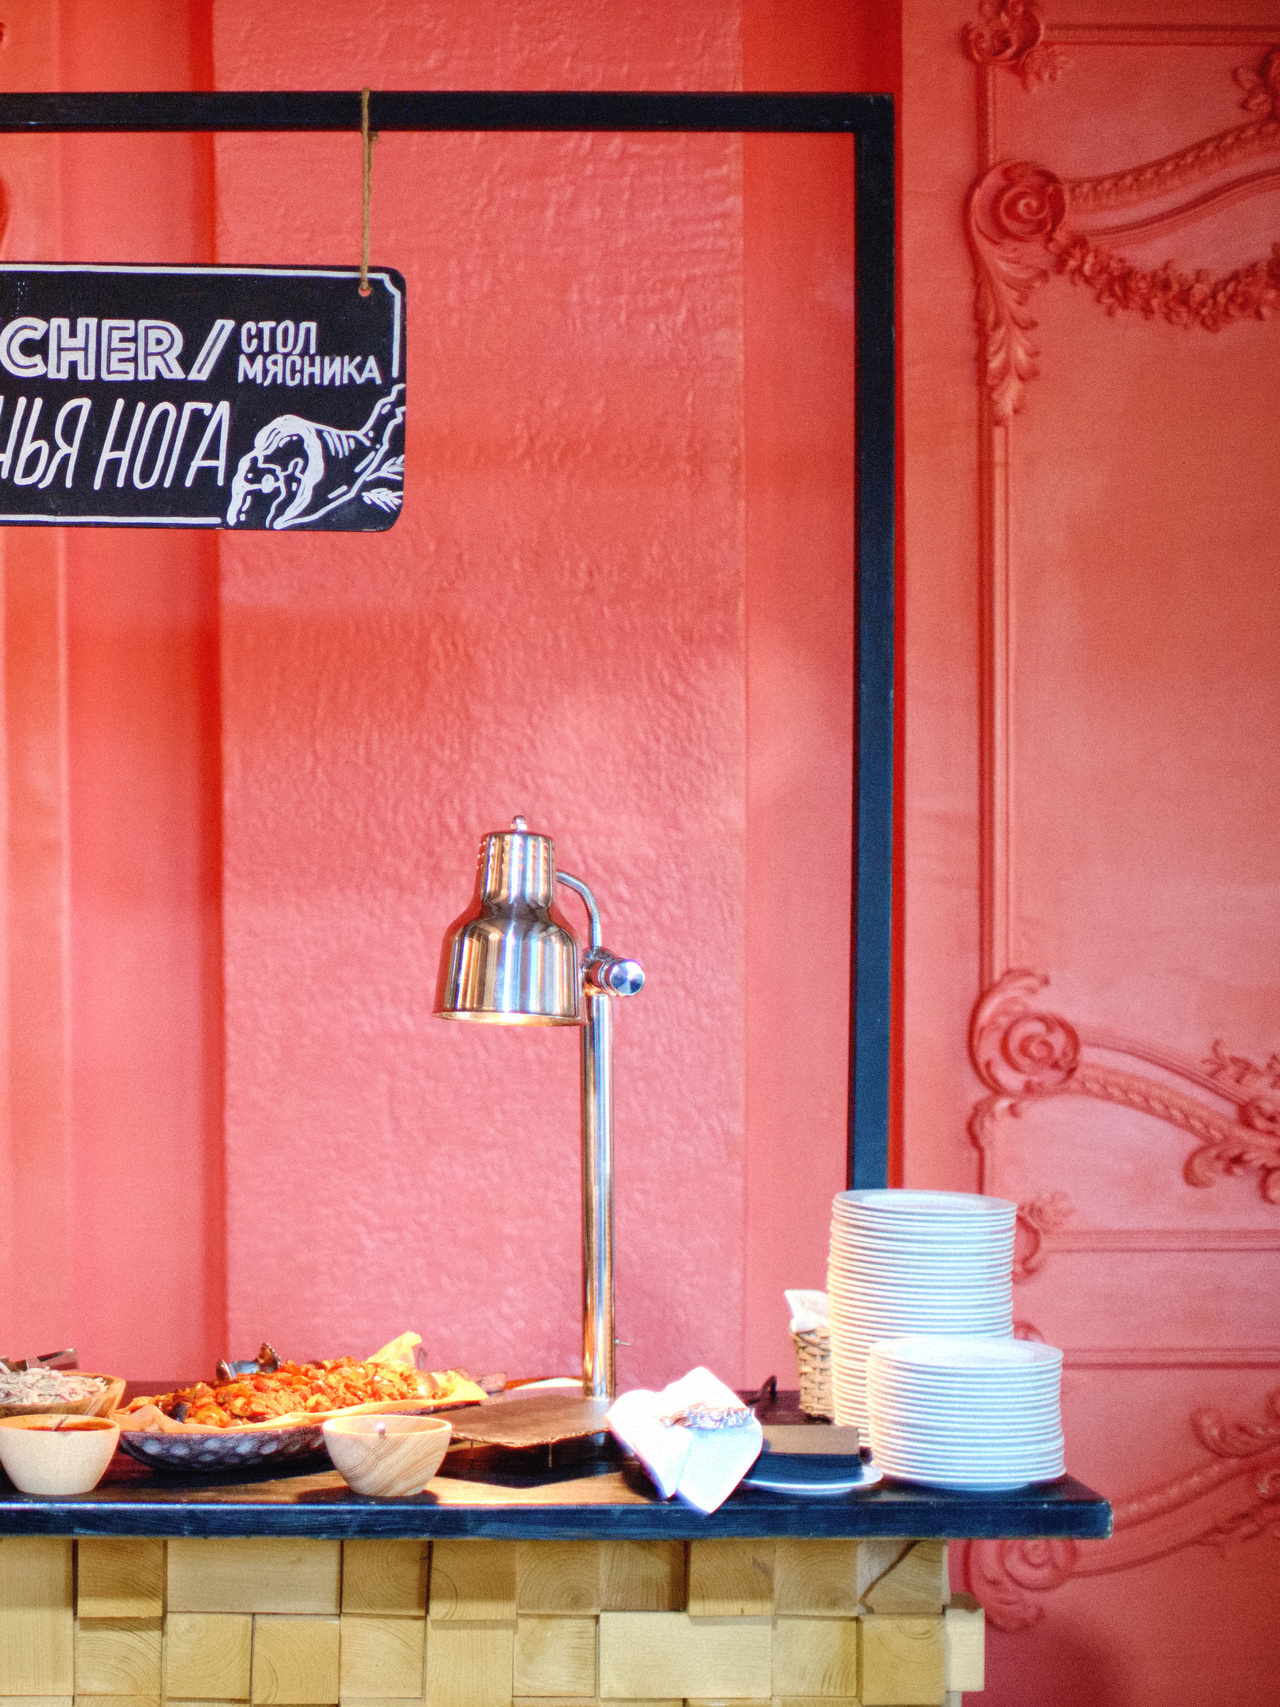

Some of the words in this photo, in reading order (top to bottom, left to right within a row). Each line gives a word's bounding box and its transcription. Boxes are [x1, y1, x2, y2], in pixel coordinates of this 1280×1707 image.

[240, 319, 317, 354] СТОЛ
[237, 354, 383, 387] МЯСНИКА
[93, 399, 231, 490] НОГА
